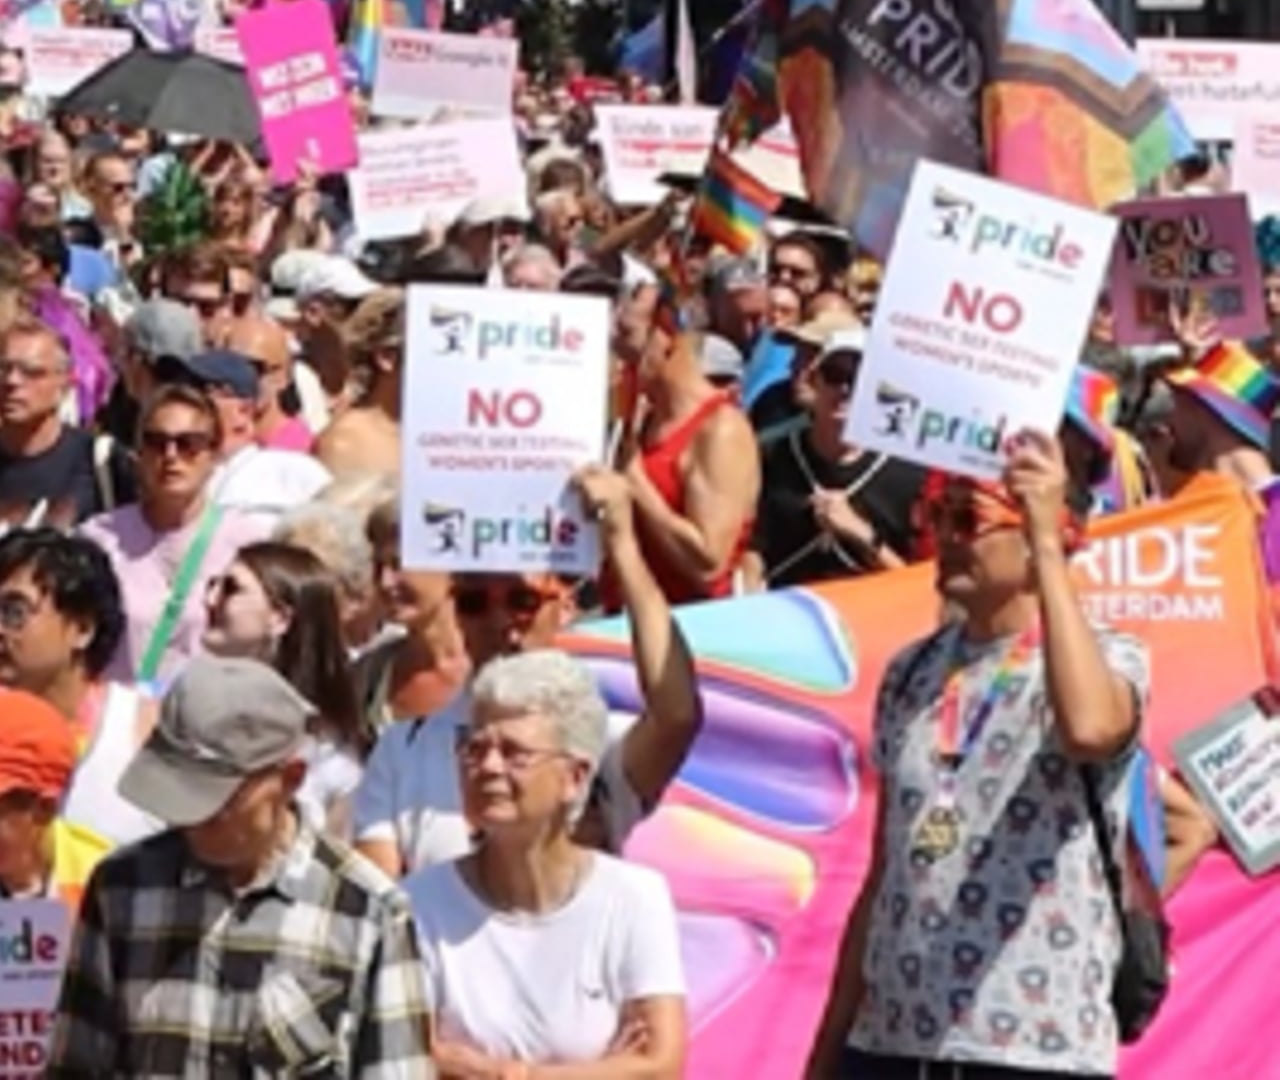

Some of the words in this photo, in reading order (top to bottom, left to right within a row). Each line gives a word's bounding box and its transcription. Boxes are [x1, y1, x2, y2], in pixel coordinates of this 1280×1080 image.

[969, 214, 1085, 269] pride
[943, 281, 1024, 334] NO
[477, 311, 585, 360] pride
[467, 388, 543, 429] NO
[473, 504, 578, 559] pride
